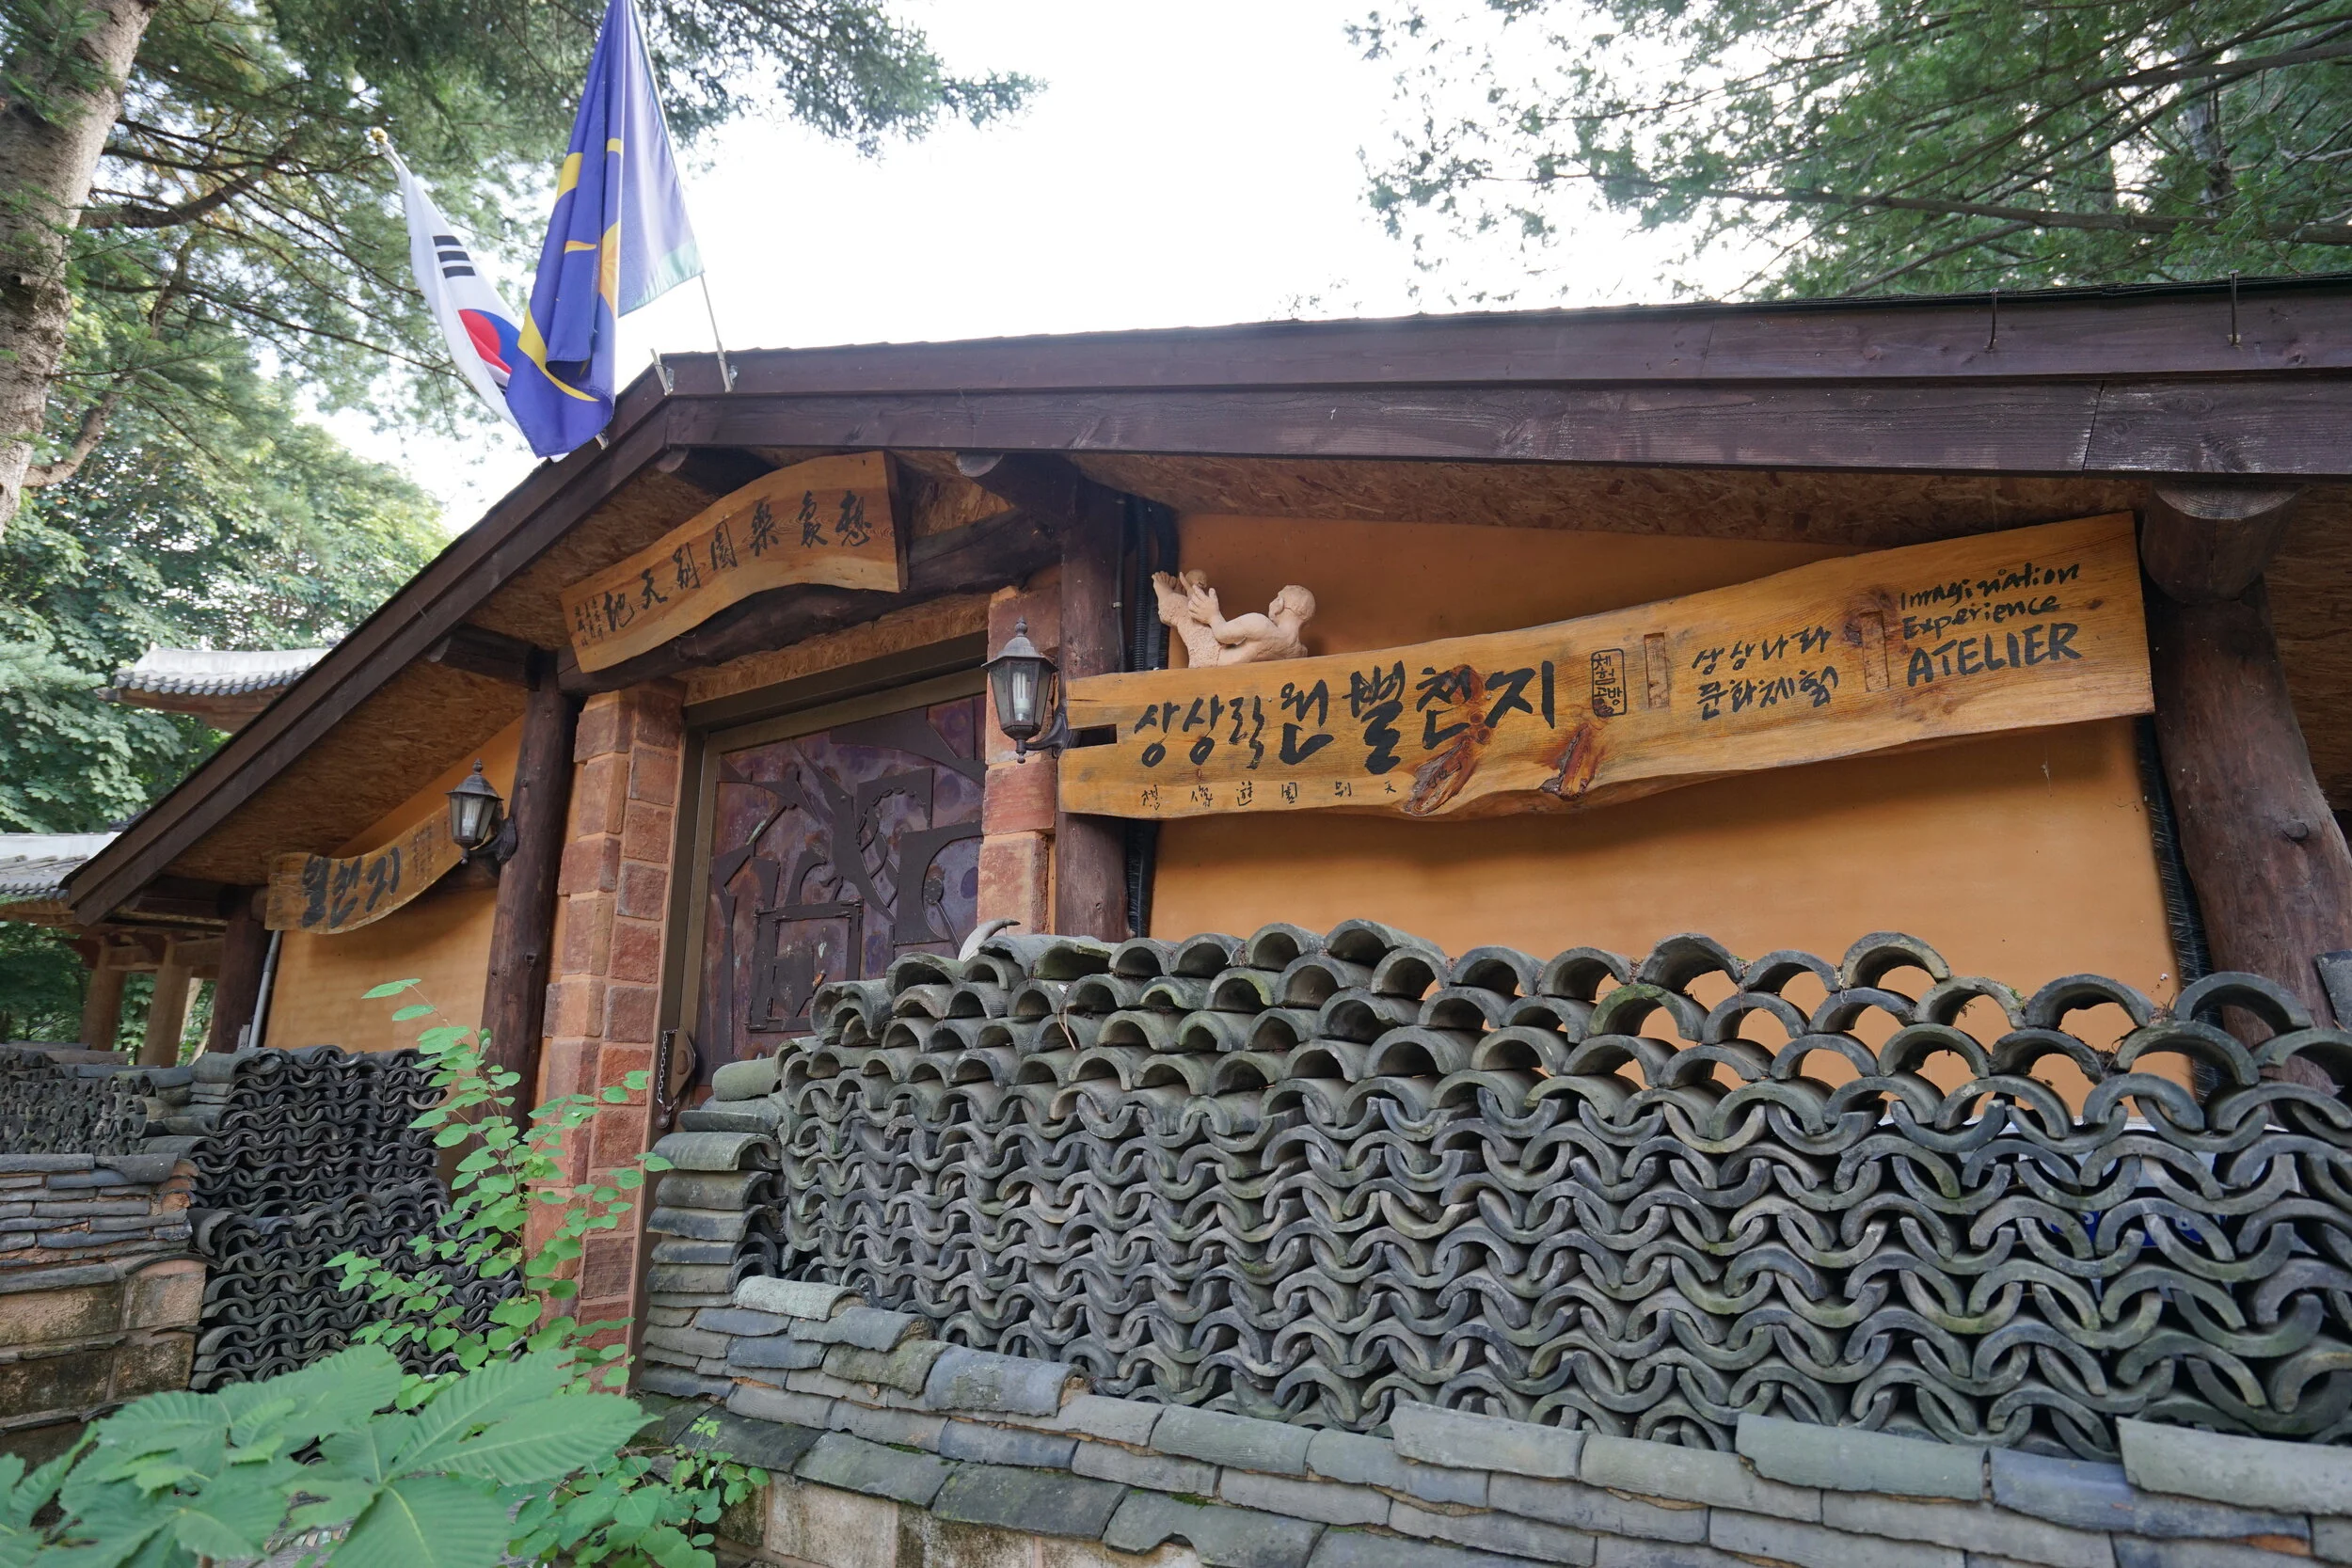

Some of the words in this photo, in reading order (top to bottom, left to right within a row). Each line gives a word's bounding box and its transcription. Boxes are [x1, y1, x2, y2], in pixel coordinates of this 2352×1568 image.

[1900, 562, 2080, 610] Imagination
[1901, 595, 2061, 640] Experience
[1692, 626, 1833, 675] 상상나라
[1907, 623, 2083, 688] ATELIER
[1697, 666, 1839, 721] 문화체험
